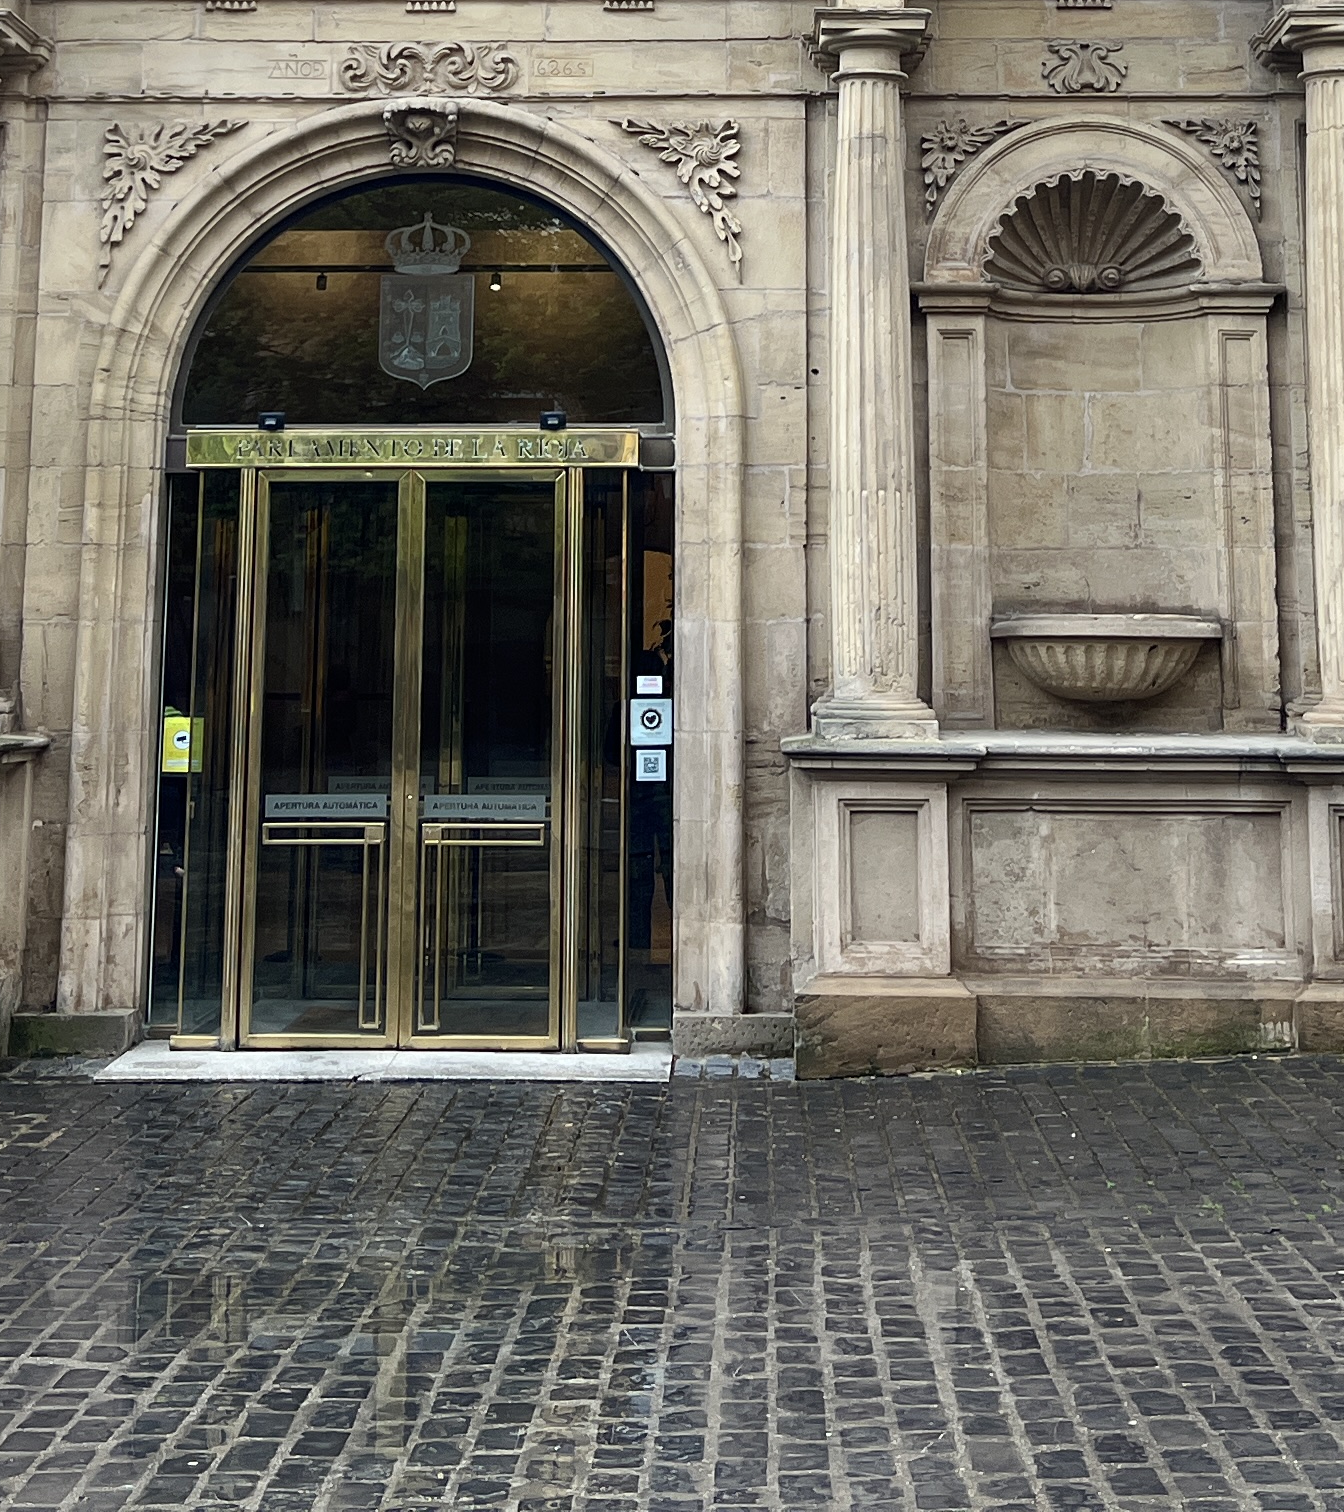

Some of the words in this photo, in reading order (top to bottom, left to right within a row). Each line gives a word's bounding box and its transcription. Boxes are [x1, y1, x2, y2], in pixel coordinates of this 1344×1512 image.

[236, 439, 423, 458] PARLAMENTO
[432, 439, 464, 458] DE
[471, 439, 508, 458] LA
[517, 439, 589, 460] RIOJA
[273, 801, 321, 810] APERTURA
[432, 802, 479, 811] APERTURA
